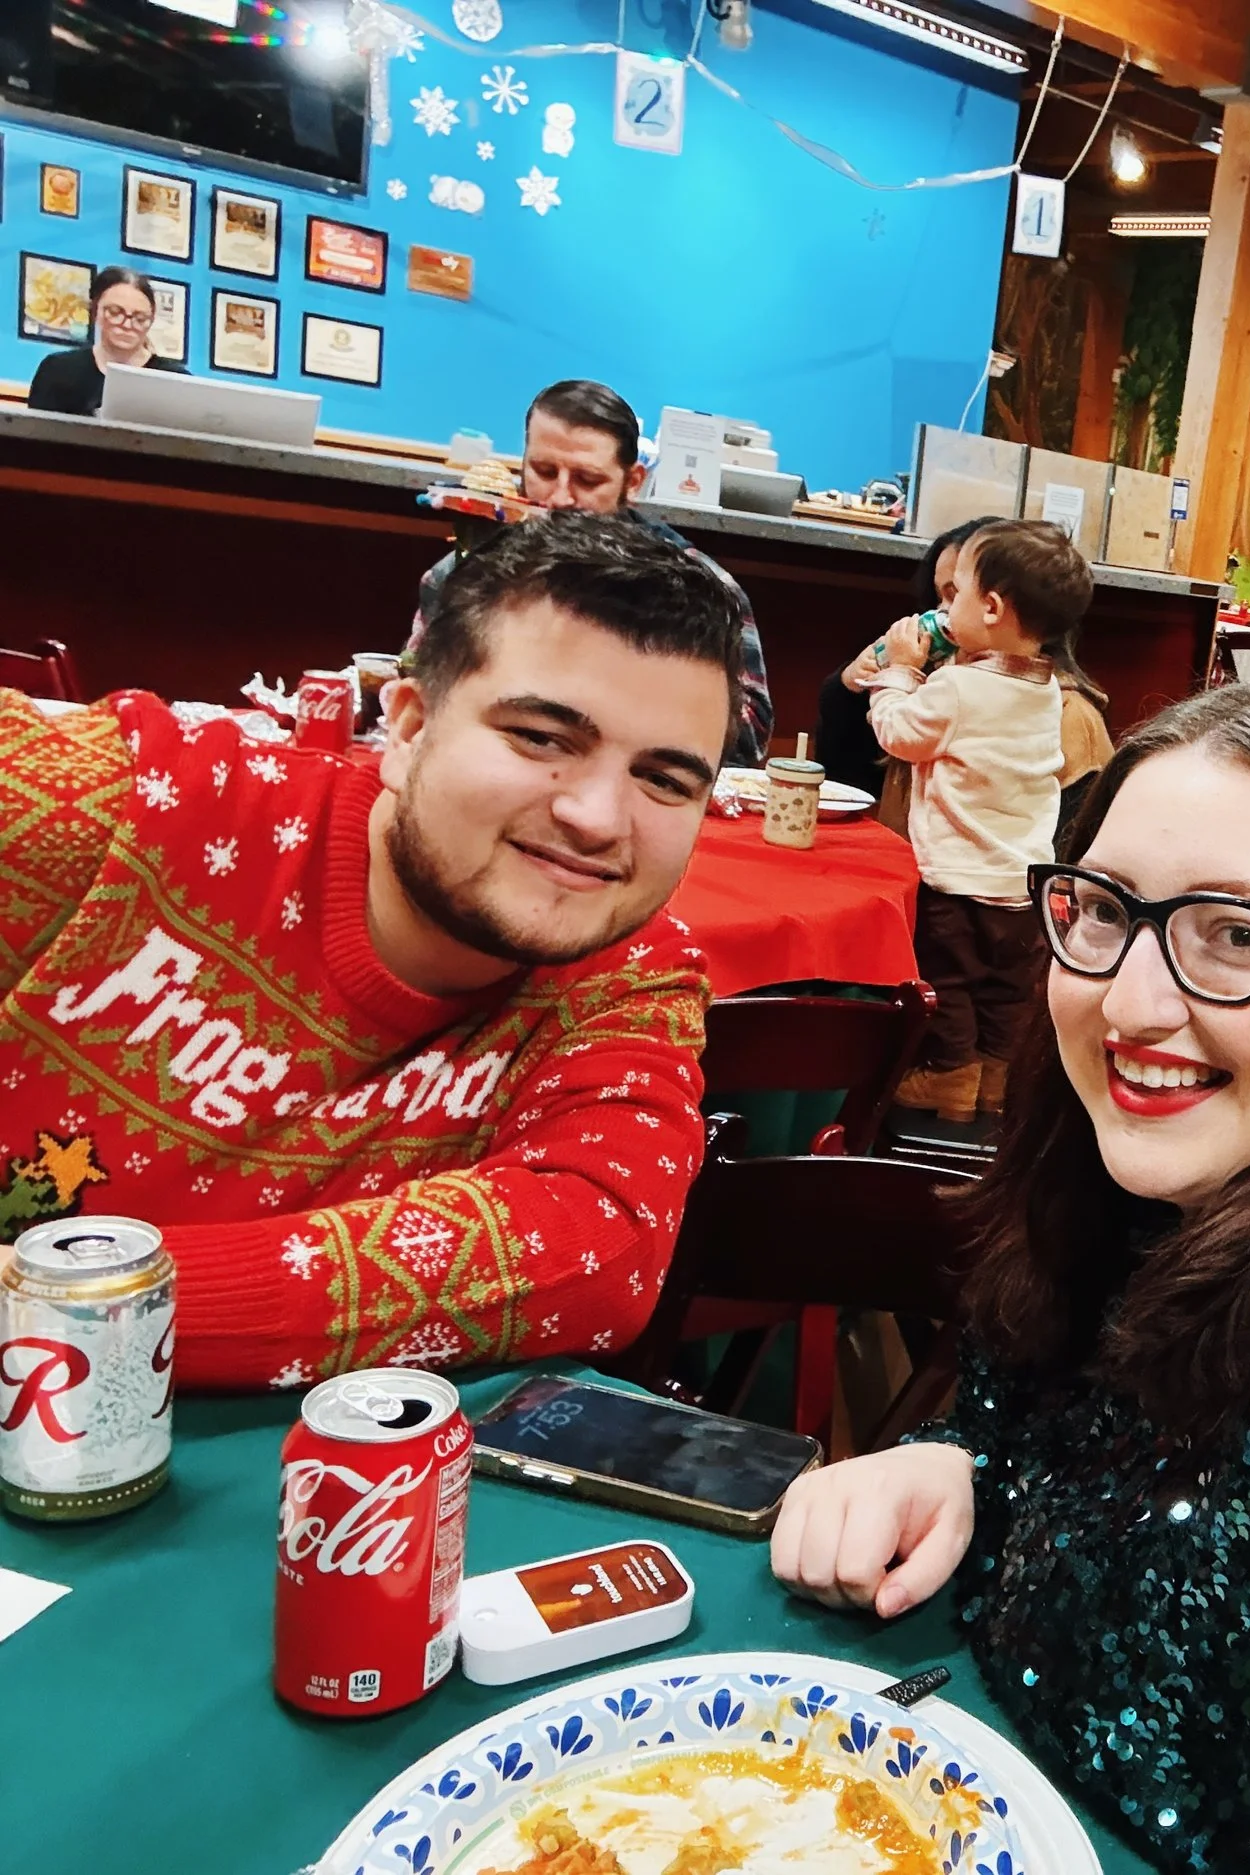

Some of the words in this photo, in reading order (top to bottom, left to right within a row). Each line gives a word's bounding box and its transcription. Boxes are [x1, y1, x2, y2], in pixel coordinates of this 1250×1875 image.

[634, 78, 665, 128] 2
[1028, 196, 1051, 237] 1
[49, 926, 292, 1127] Frog
[0, 1337, 91, 1444] R
[434, 1424, 467, 1457] Coke
[517, 1400, 583, 1440] 7:53
[354, 1673, 377, 1687] 140
